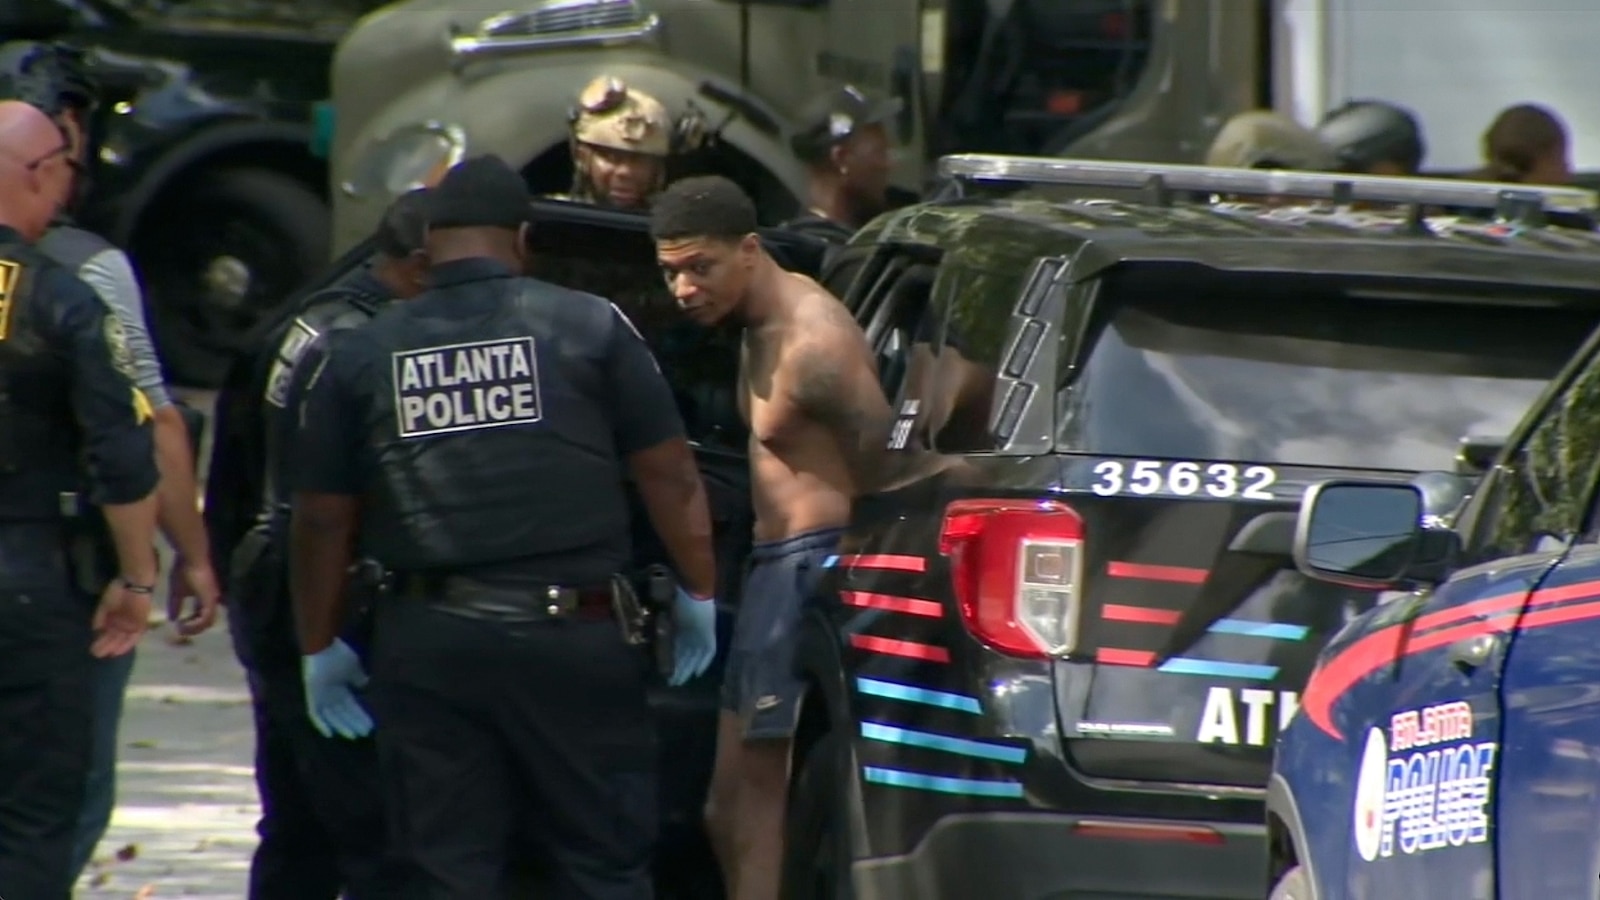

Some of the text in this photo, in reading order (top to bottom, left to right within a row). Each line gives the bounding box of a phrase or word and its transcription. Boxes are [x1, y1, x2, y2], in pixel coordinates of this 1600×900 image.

[401, 344, 530, 391] ATLANTA
[402, 383, 536, 431] POLICE
[1092, 461, 1276, 500] 35632
[1391, 701, 1472, 751] ATLANTA
[1380, 742, 1497, 857] POLICE
